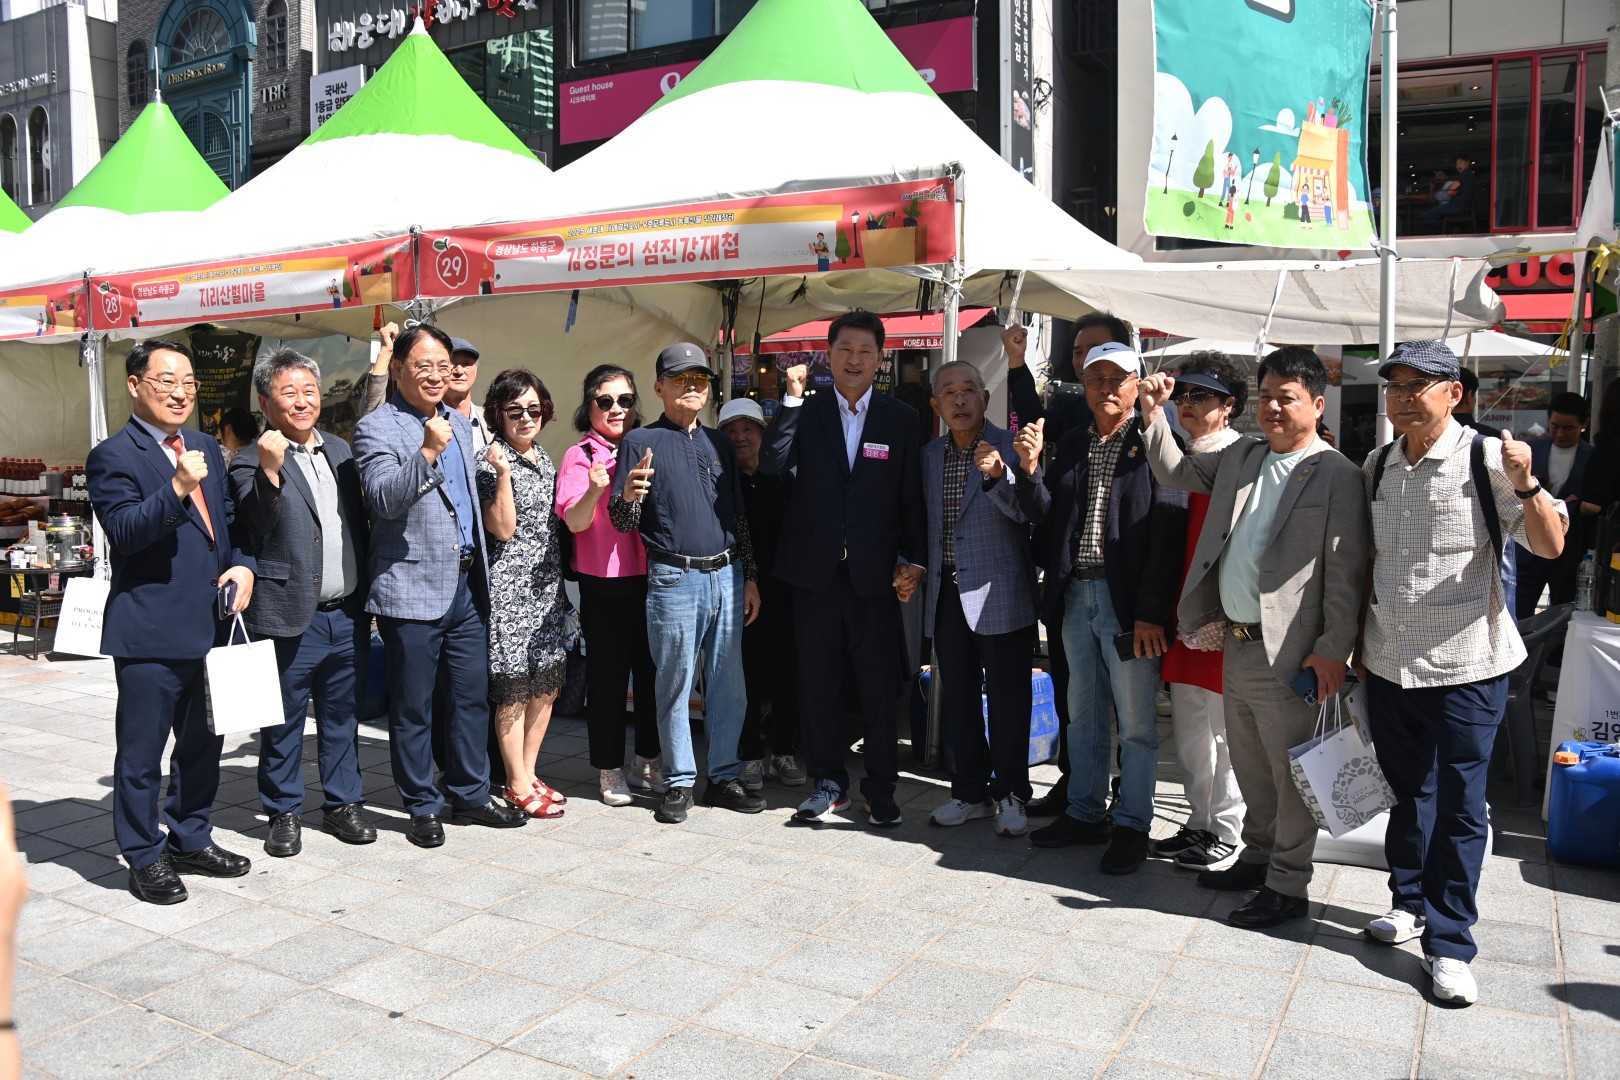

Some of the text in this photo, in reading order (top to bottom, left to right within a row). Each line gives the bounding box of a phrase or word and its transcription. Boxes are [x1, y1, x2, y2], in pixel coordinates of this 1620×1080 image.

[328, 8, 406, 51] 해운대
[1014, 42, 1022, 63] 집
[261, 82, 288, 103] TBR
[325, 81, 347, 96] 국내산
[569, 81, 614, 95] Guest house
[315, 99, 333, 113] 1등급
[568, 228, 585, 237] 2025
[494, 240, 557, 256] 경상남도 하동군
[567, 231, 740, 272] 김정문의 섬진강재첩
[442, 256, 462, 277] 29
[137, 284, 175, 297] 경상남도 하동군
[105, 297, 118, 314] 28
[903, 338, 925, 347] KOREA
[1605, 710, 1620, 720] 1번
